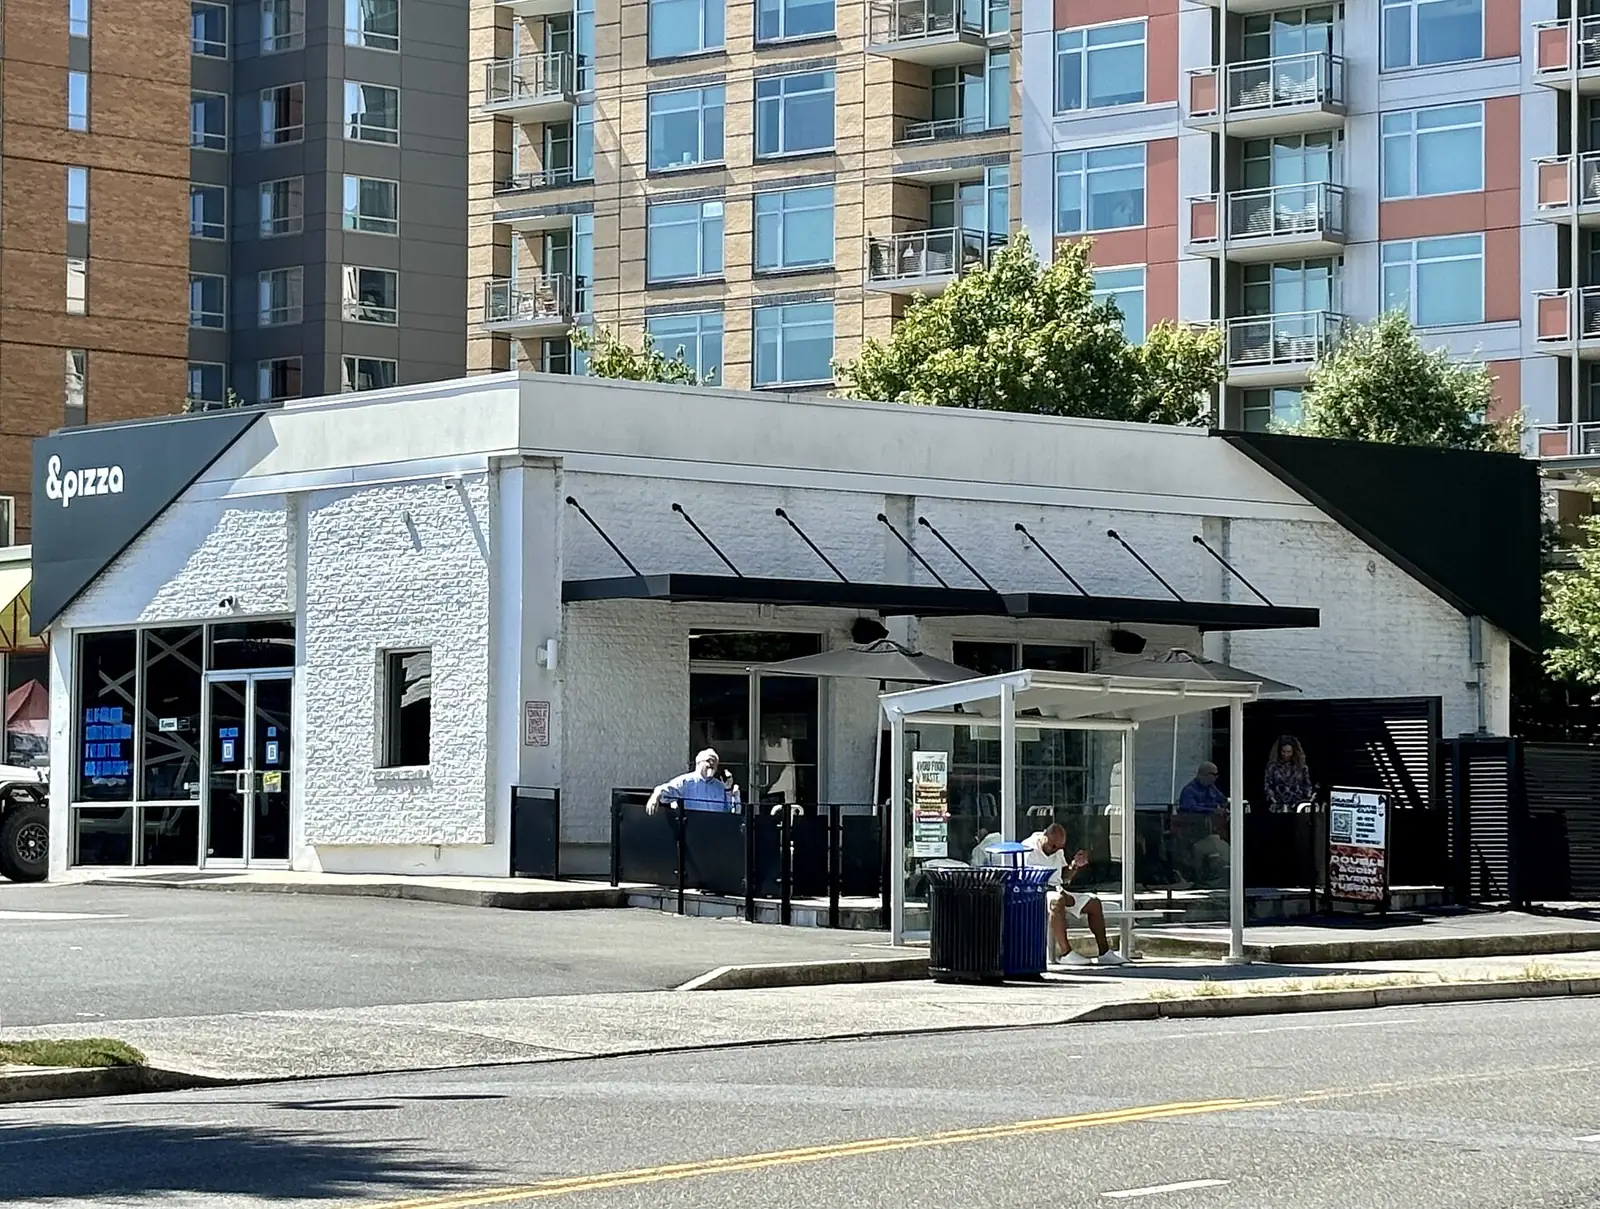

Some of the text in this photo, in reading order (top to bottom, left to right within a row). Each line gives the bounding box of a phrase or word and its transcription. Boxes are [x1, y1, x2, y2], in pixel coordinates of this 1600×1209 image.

[46, 455, 124, 507] &pizza
[1330, 855, 1384, 867] DOUBLE
[1338, 874, 1377, 884] EVERY
[1330, 881, 1384, 892] TUESDAY
